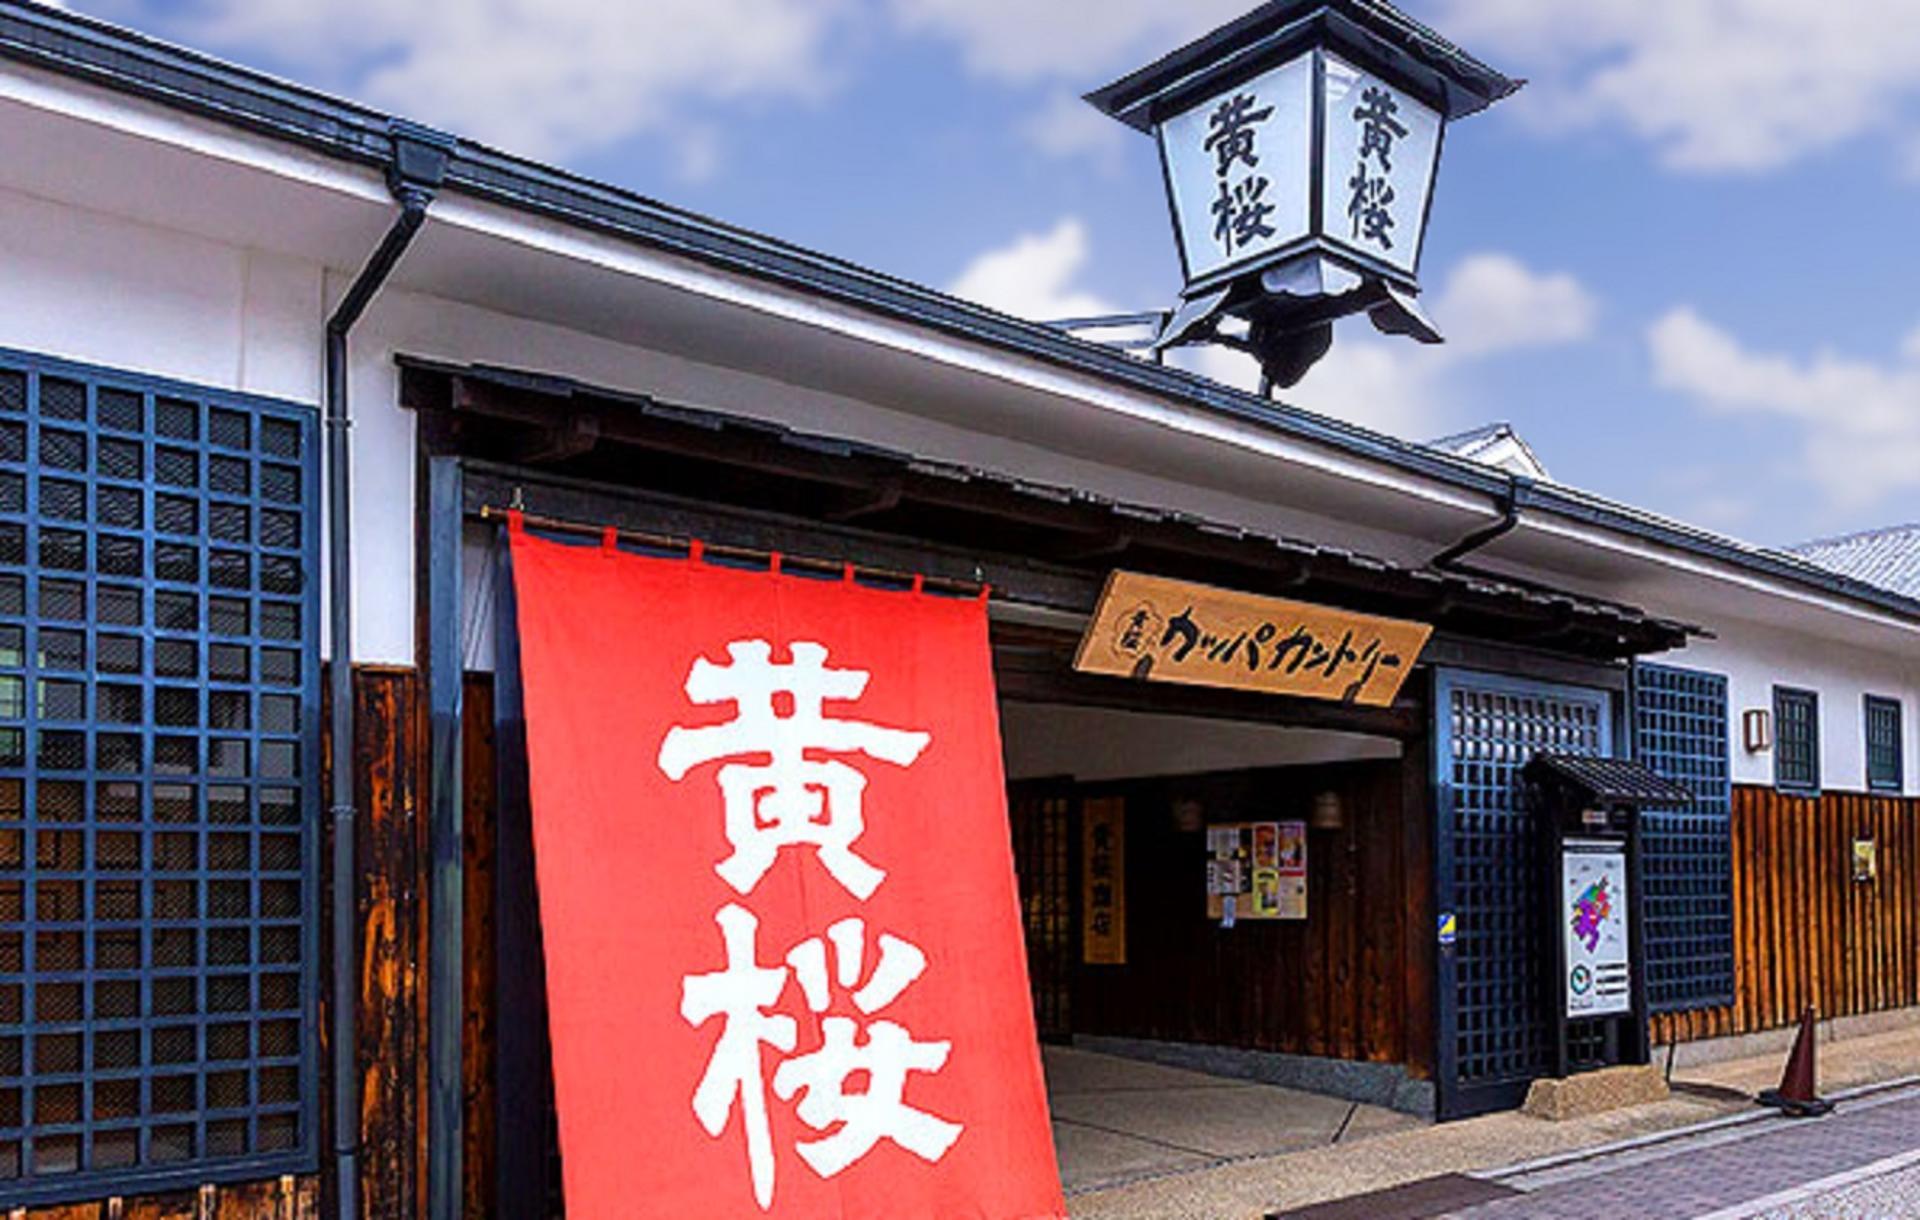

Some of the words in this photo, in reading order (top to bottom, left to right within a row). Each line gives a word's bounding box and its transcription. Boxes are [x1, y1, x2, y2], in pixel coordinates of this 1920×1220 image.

[1204, 94, 1277, 257] 黄桜
[1348, 87, 1408, 250] 黄桜
[1160, 606, 1400, 686] カッパカントリー
[658, 639, 964, 1211] 黄桜
